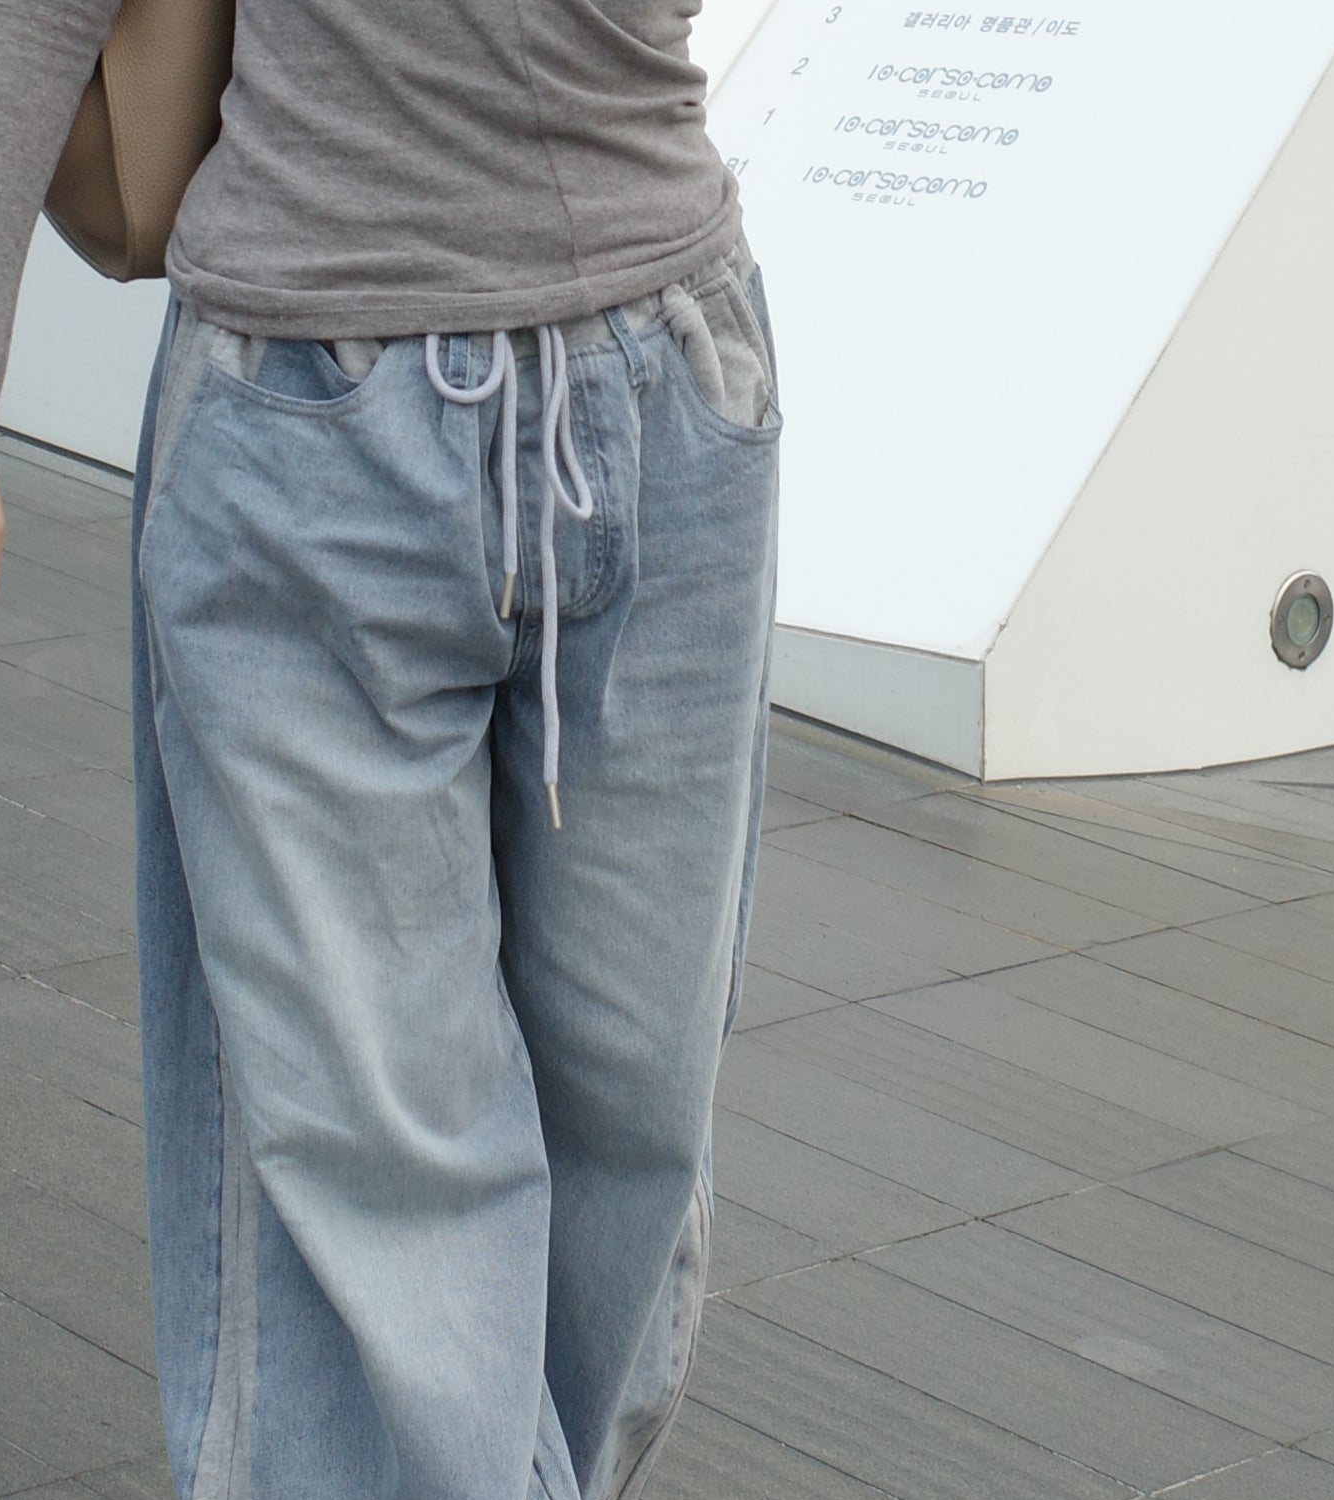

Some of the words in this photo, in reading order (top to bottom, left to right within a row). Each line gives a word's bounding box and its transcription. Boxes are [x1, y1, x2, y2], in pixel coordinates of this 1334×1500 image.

[824, 6, 842, 25] 3
[978, 15, 1034, 35] 명품관
[790, 56, 809, 76] 2
[915, 87, 982, 103] SEOUL
[762, 107, 776, 127] 1
[882, 140, 948, 155] SEOUL
[850, 191, 916, 207] SEOUL
